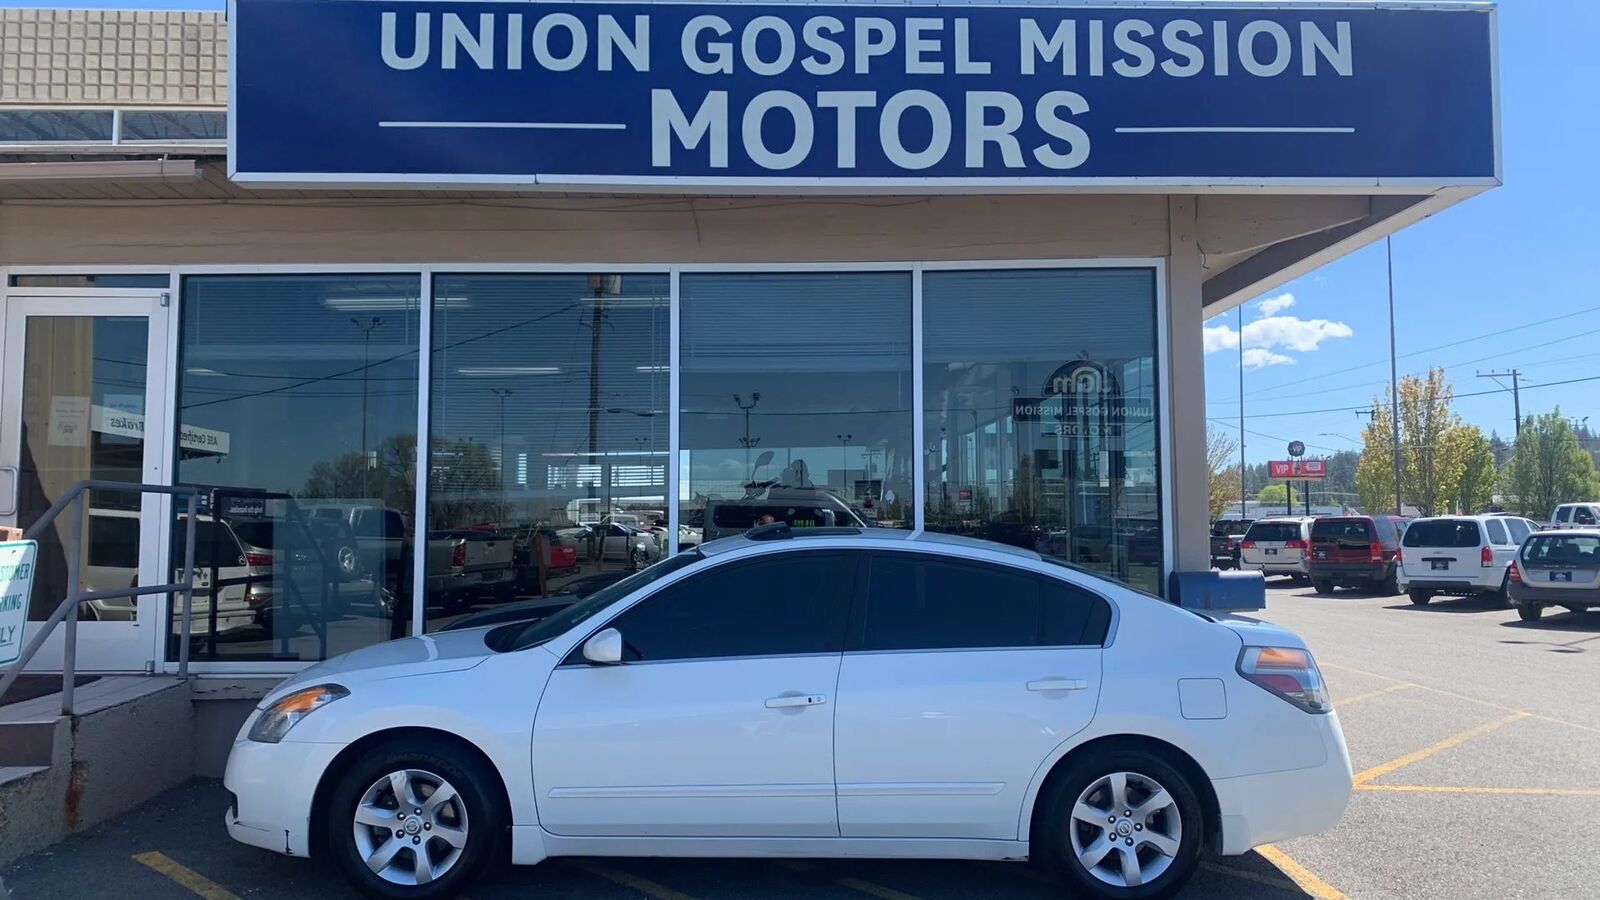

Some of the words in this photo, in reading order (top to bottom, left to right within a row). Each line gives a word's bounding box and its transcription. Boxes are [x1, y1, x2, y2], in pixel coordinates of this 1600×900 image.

[381, 12, 650, 71] UNION
[681, 15, 991, 75] GOSPEL
[1020, 18, 1353, 77] MISSION
[651, 88, 1091, 169] MOTORS
